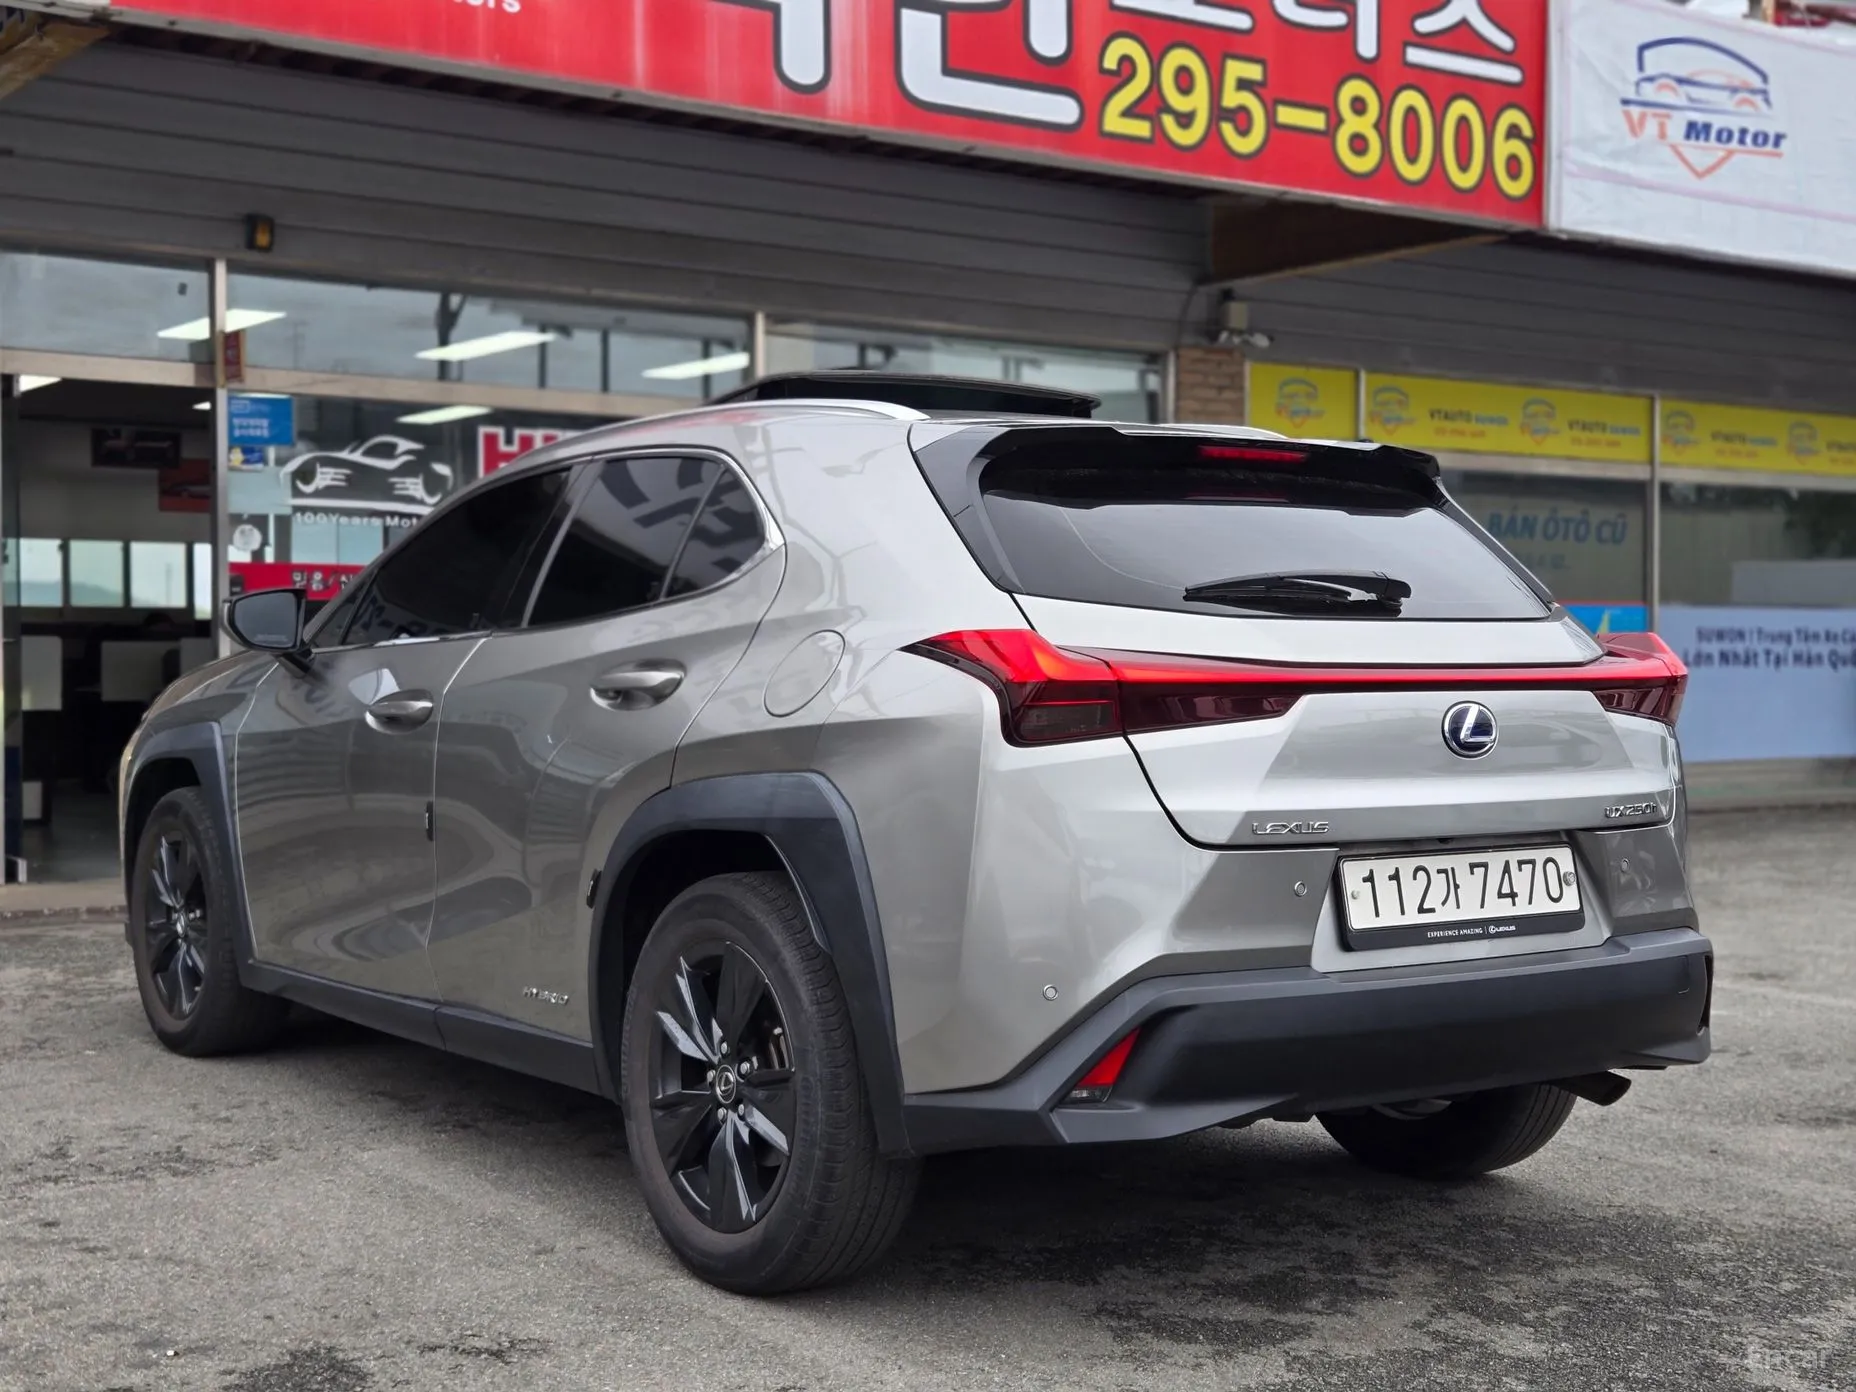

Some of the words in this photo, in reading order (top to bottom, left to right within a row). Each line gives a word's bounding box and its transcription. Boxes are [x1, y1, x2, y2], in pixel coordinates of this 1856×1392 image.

[1101, 35, 1536, 199] 295-8006
[1622, 108, 1673, 141] VT
[1684, 119, 1788, 149] Motor
[1252, 821, 1330, 836] LEXUS
[1427, 929, 1459, 938] EXPERIENCE
[1460, 927, 1483, 936] AMAZING
